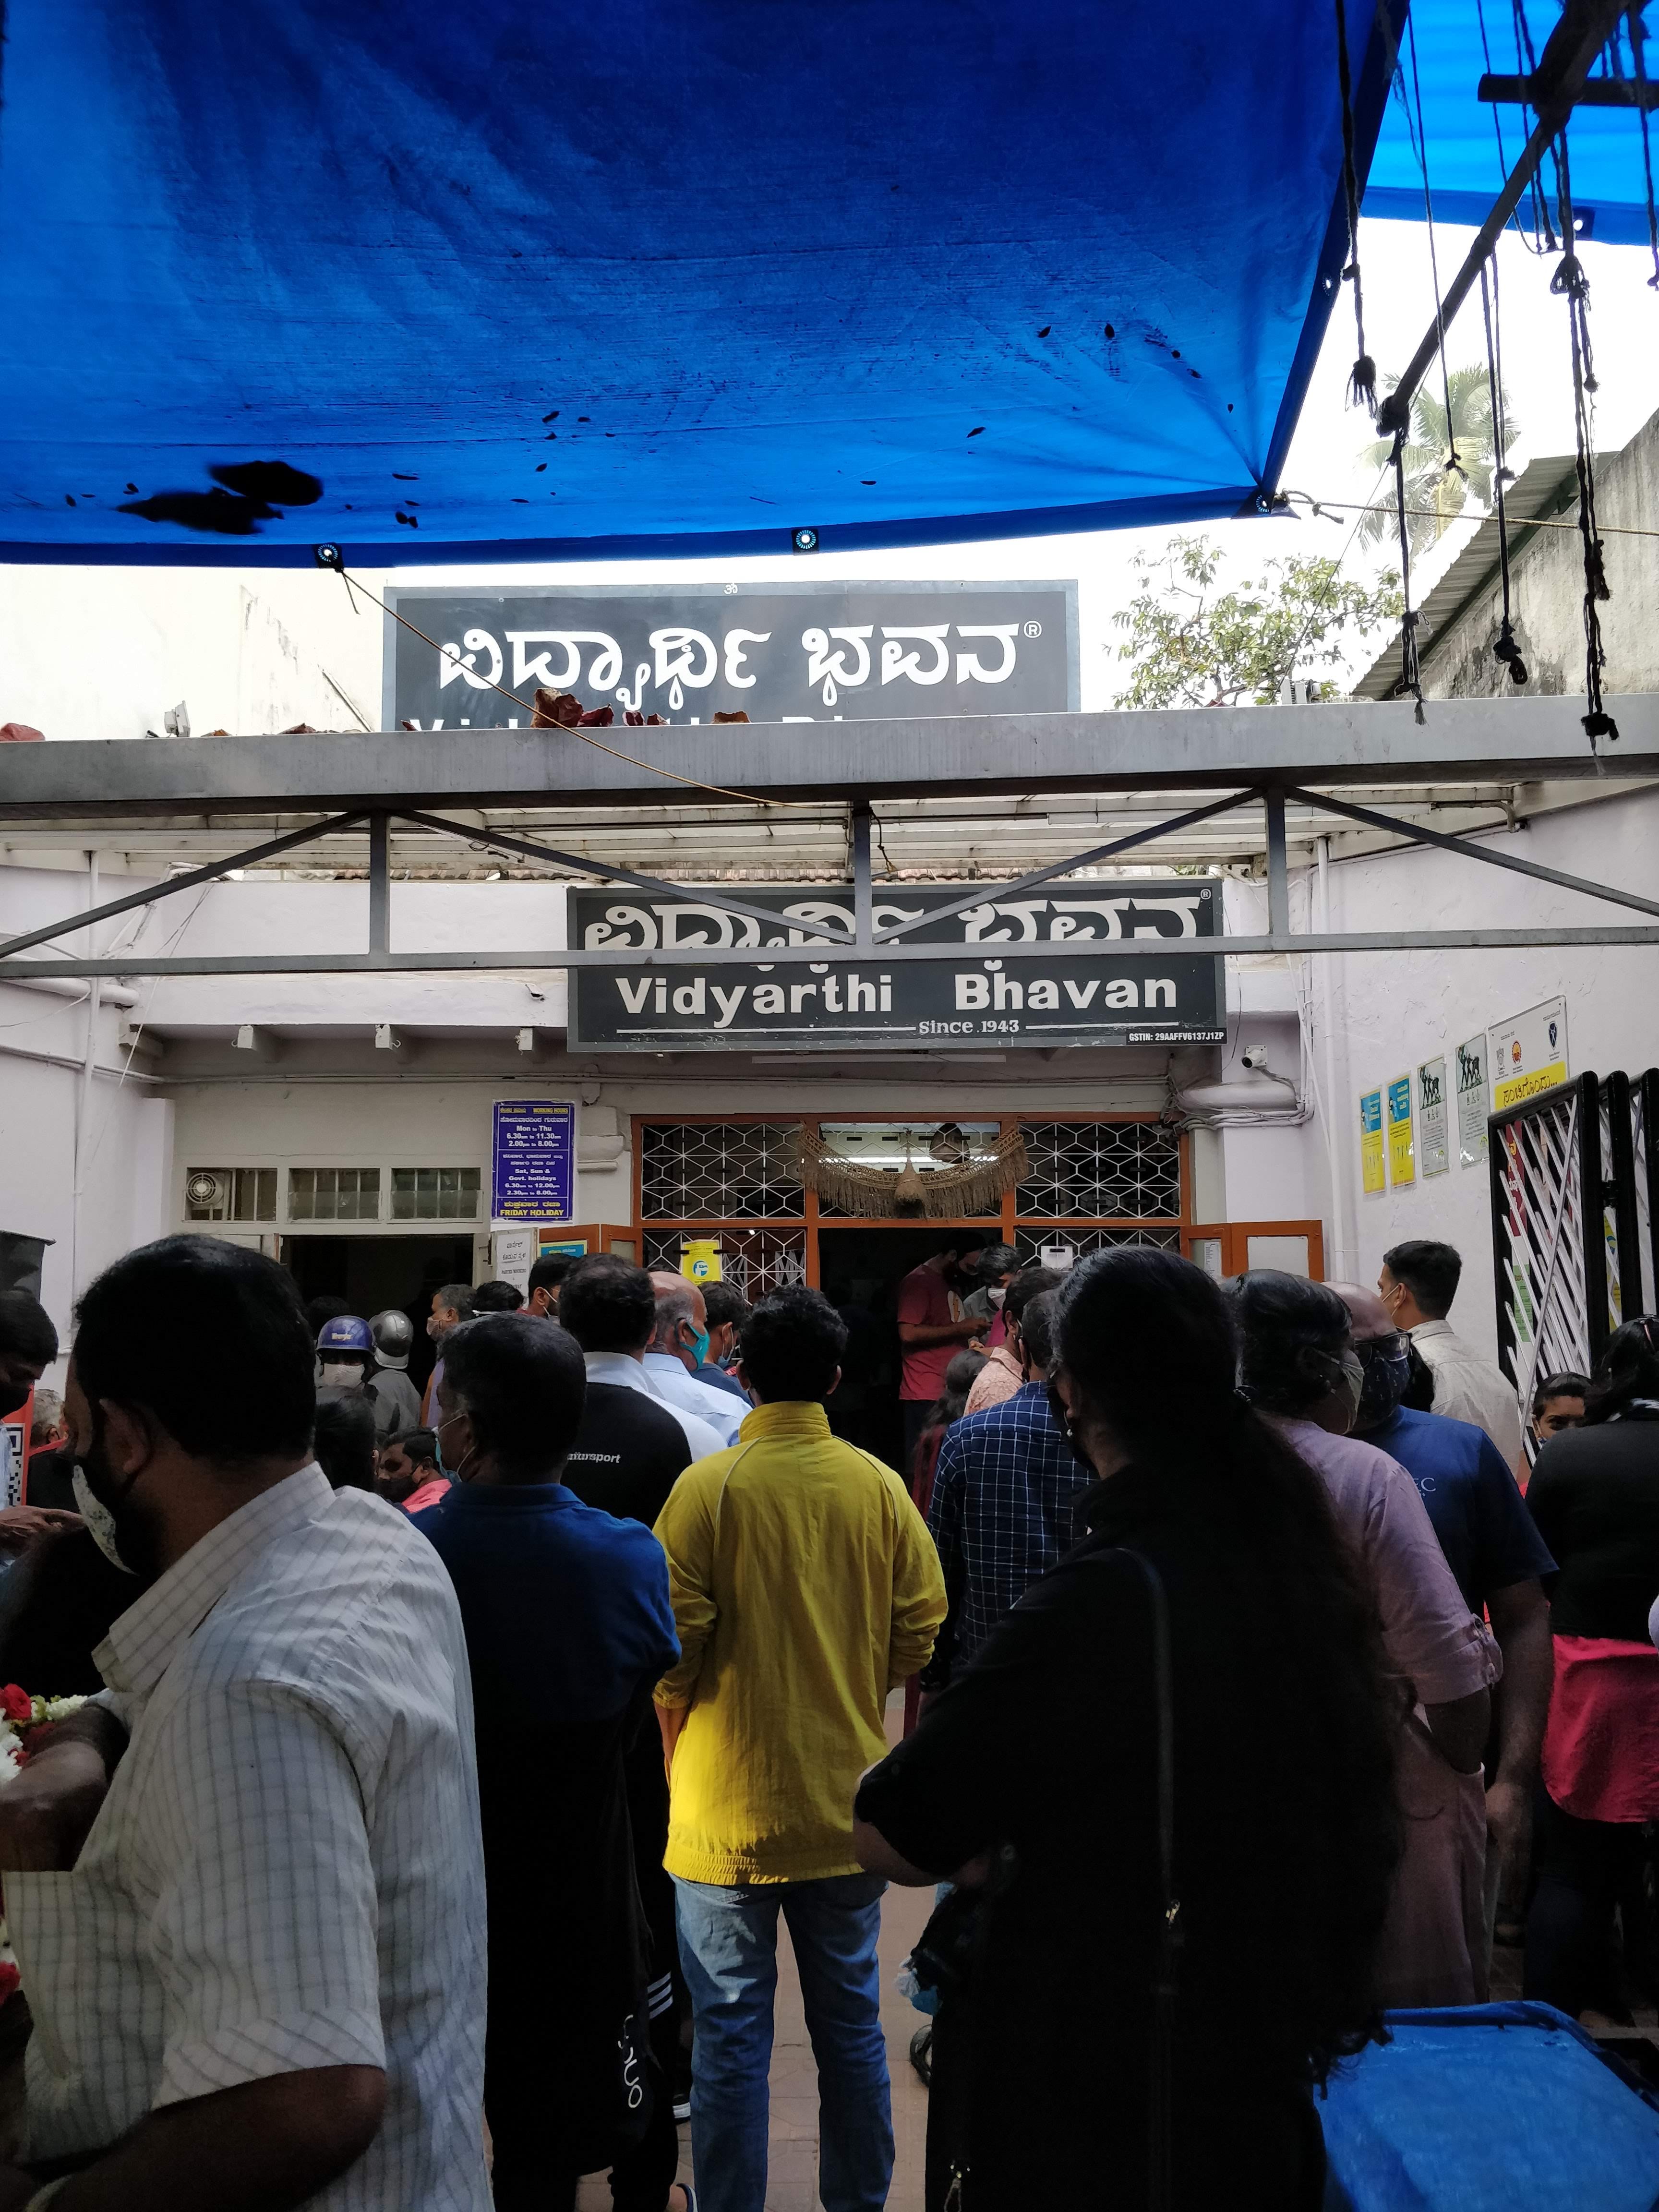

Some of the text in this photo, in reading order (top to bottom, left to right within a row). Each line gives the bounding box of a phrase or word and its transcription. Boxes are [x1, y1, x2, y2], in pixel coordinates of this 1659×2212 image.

[801, 623, 1020, 707] ಭವನ
[615, 972, 1178, 1028] Vidyarthi Bhavan
[918, 1021, 974, 1034] Since
[1155, 1032, 1224, 1041] 29AAFFV6137J1ZP
